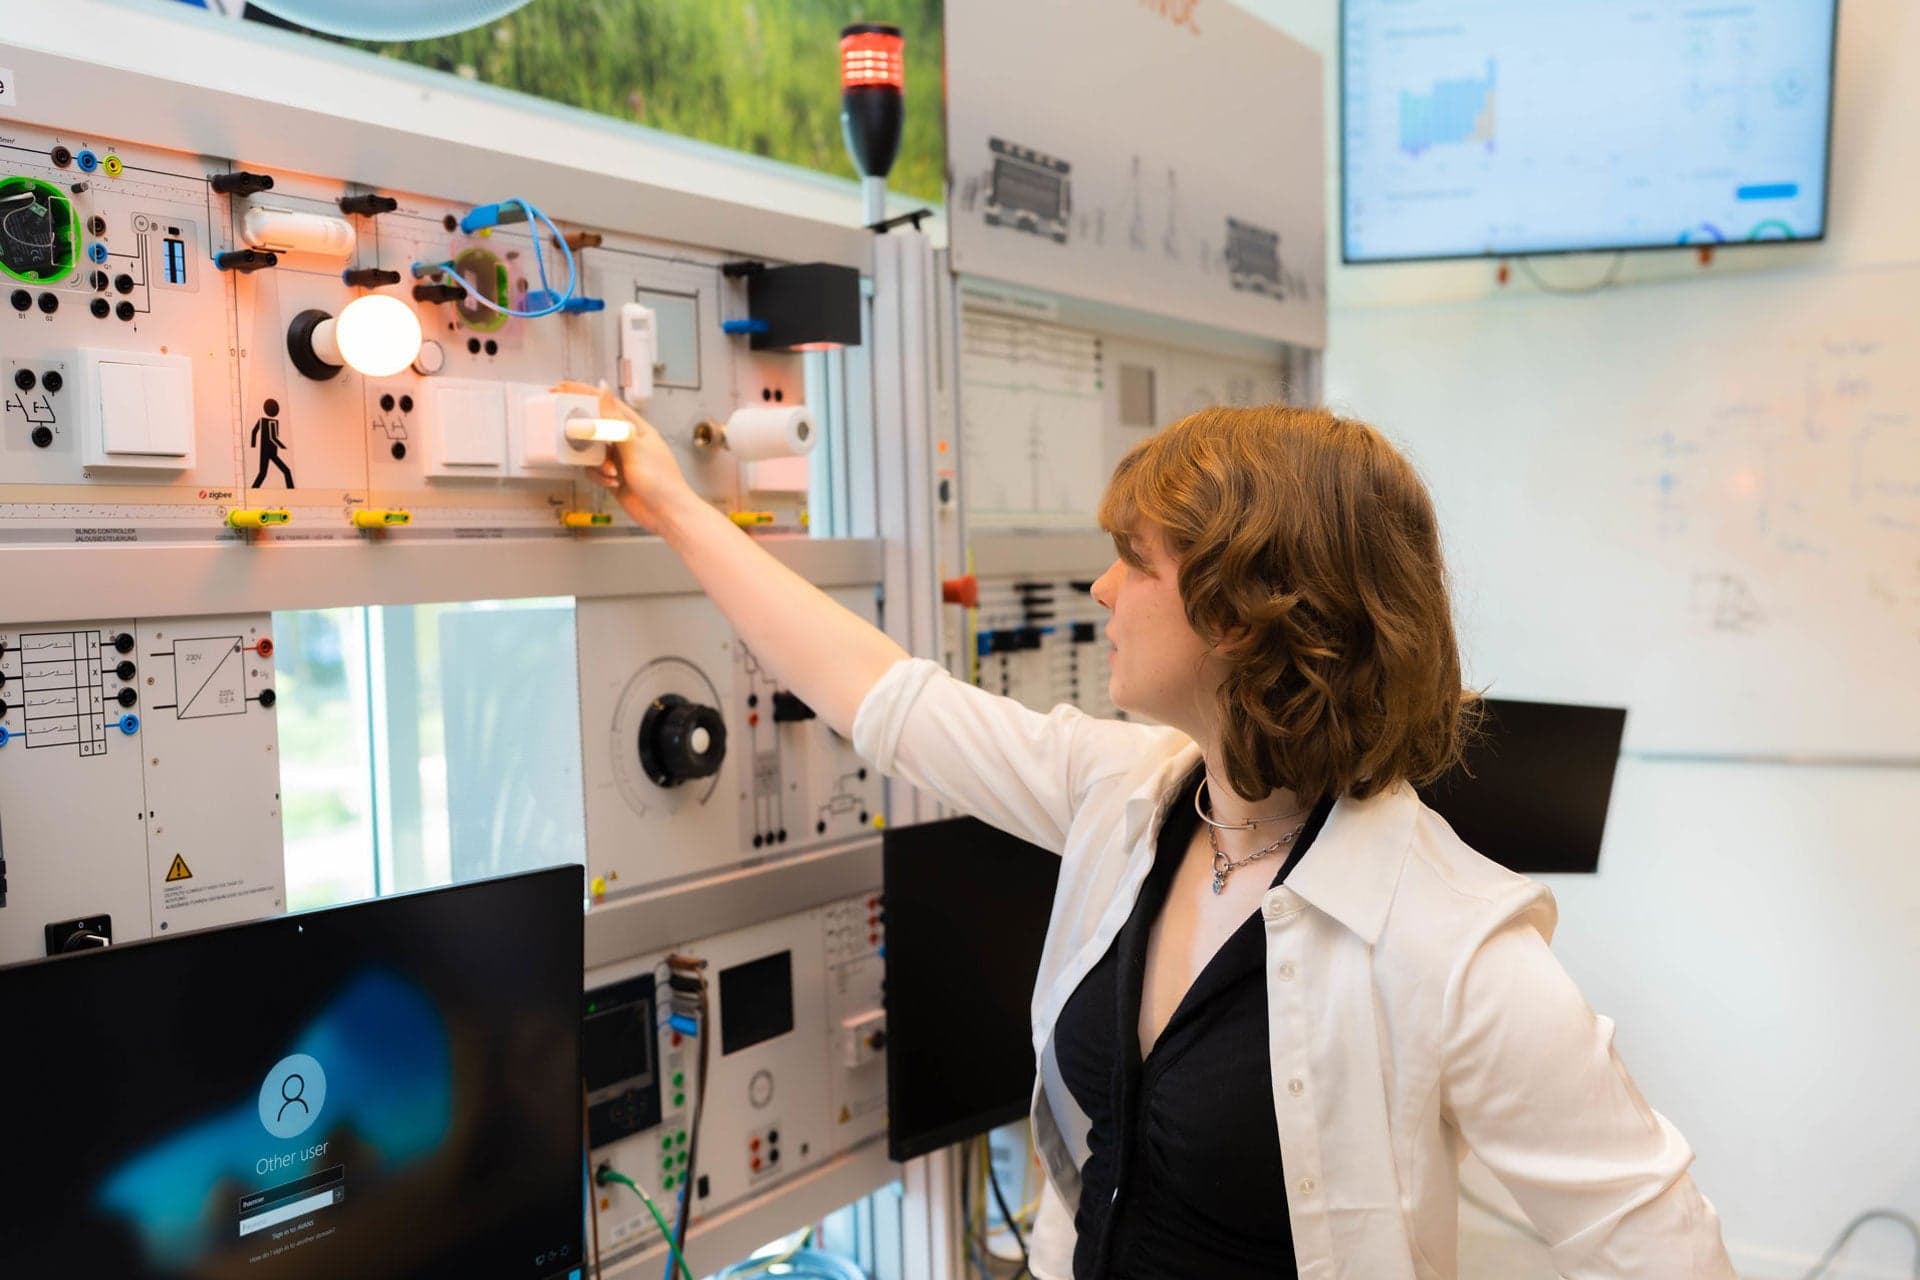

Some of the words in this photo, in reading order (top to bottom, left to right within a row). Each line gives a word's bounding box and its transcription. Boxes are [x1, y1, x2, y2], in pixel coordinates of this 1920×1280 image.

[208, 491, 233, 500] zigbee
[84, 744, 89, 752] 0
[78, 921, 85, 929] 0
[256, 1152, 297, 1175] Other
[300, 1142, 328, 1161] user
